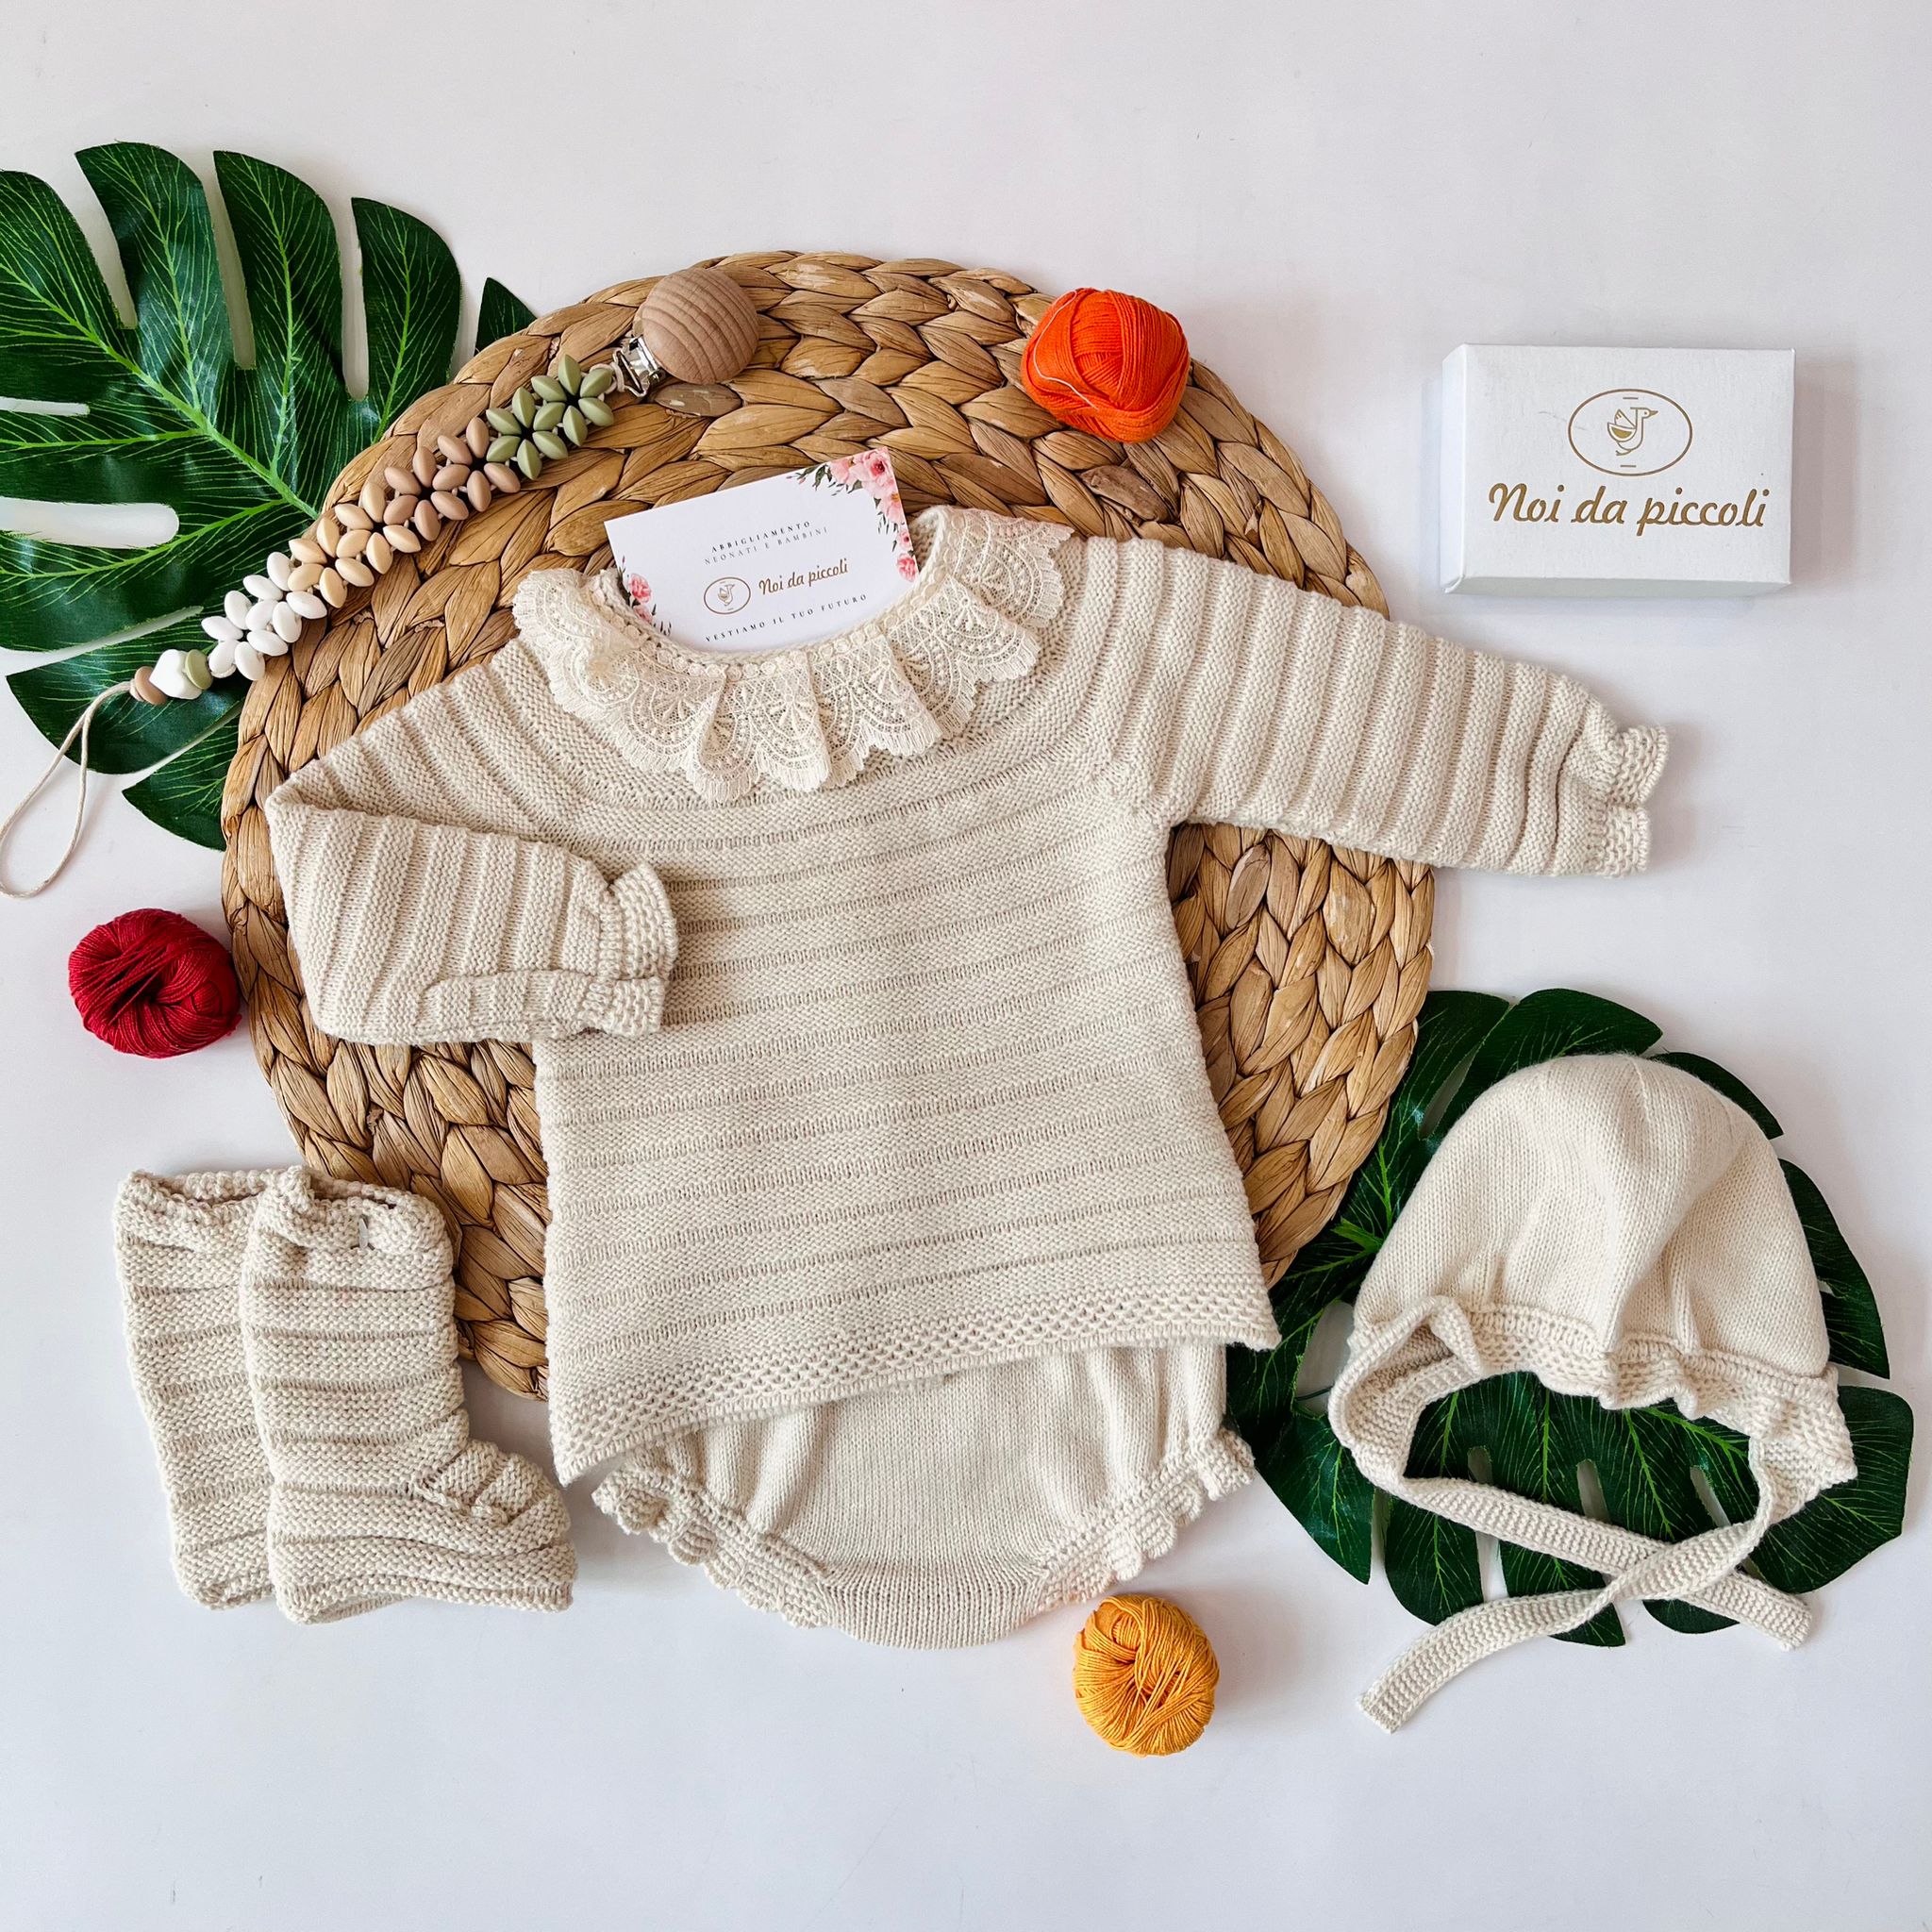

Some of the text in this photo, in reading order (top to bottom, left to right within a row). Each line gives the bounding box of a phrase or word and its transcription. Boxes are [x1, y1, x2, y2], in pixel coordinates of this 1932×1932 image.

[1489, 482, 1771, 537] Noi da piccoli
[704, 545, 758, 565] NEONATI
[777, 526, 829, 546] BAMBINI
[711, 521, 811, 553] ABBIGLIAMENTO
[758, 558, 849, 595] Noi da piccoli
[706, 593, 868, 642] VESTIAMO IL TUO FUTURO
